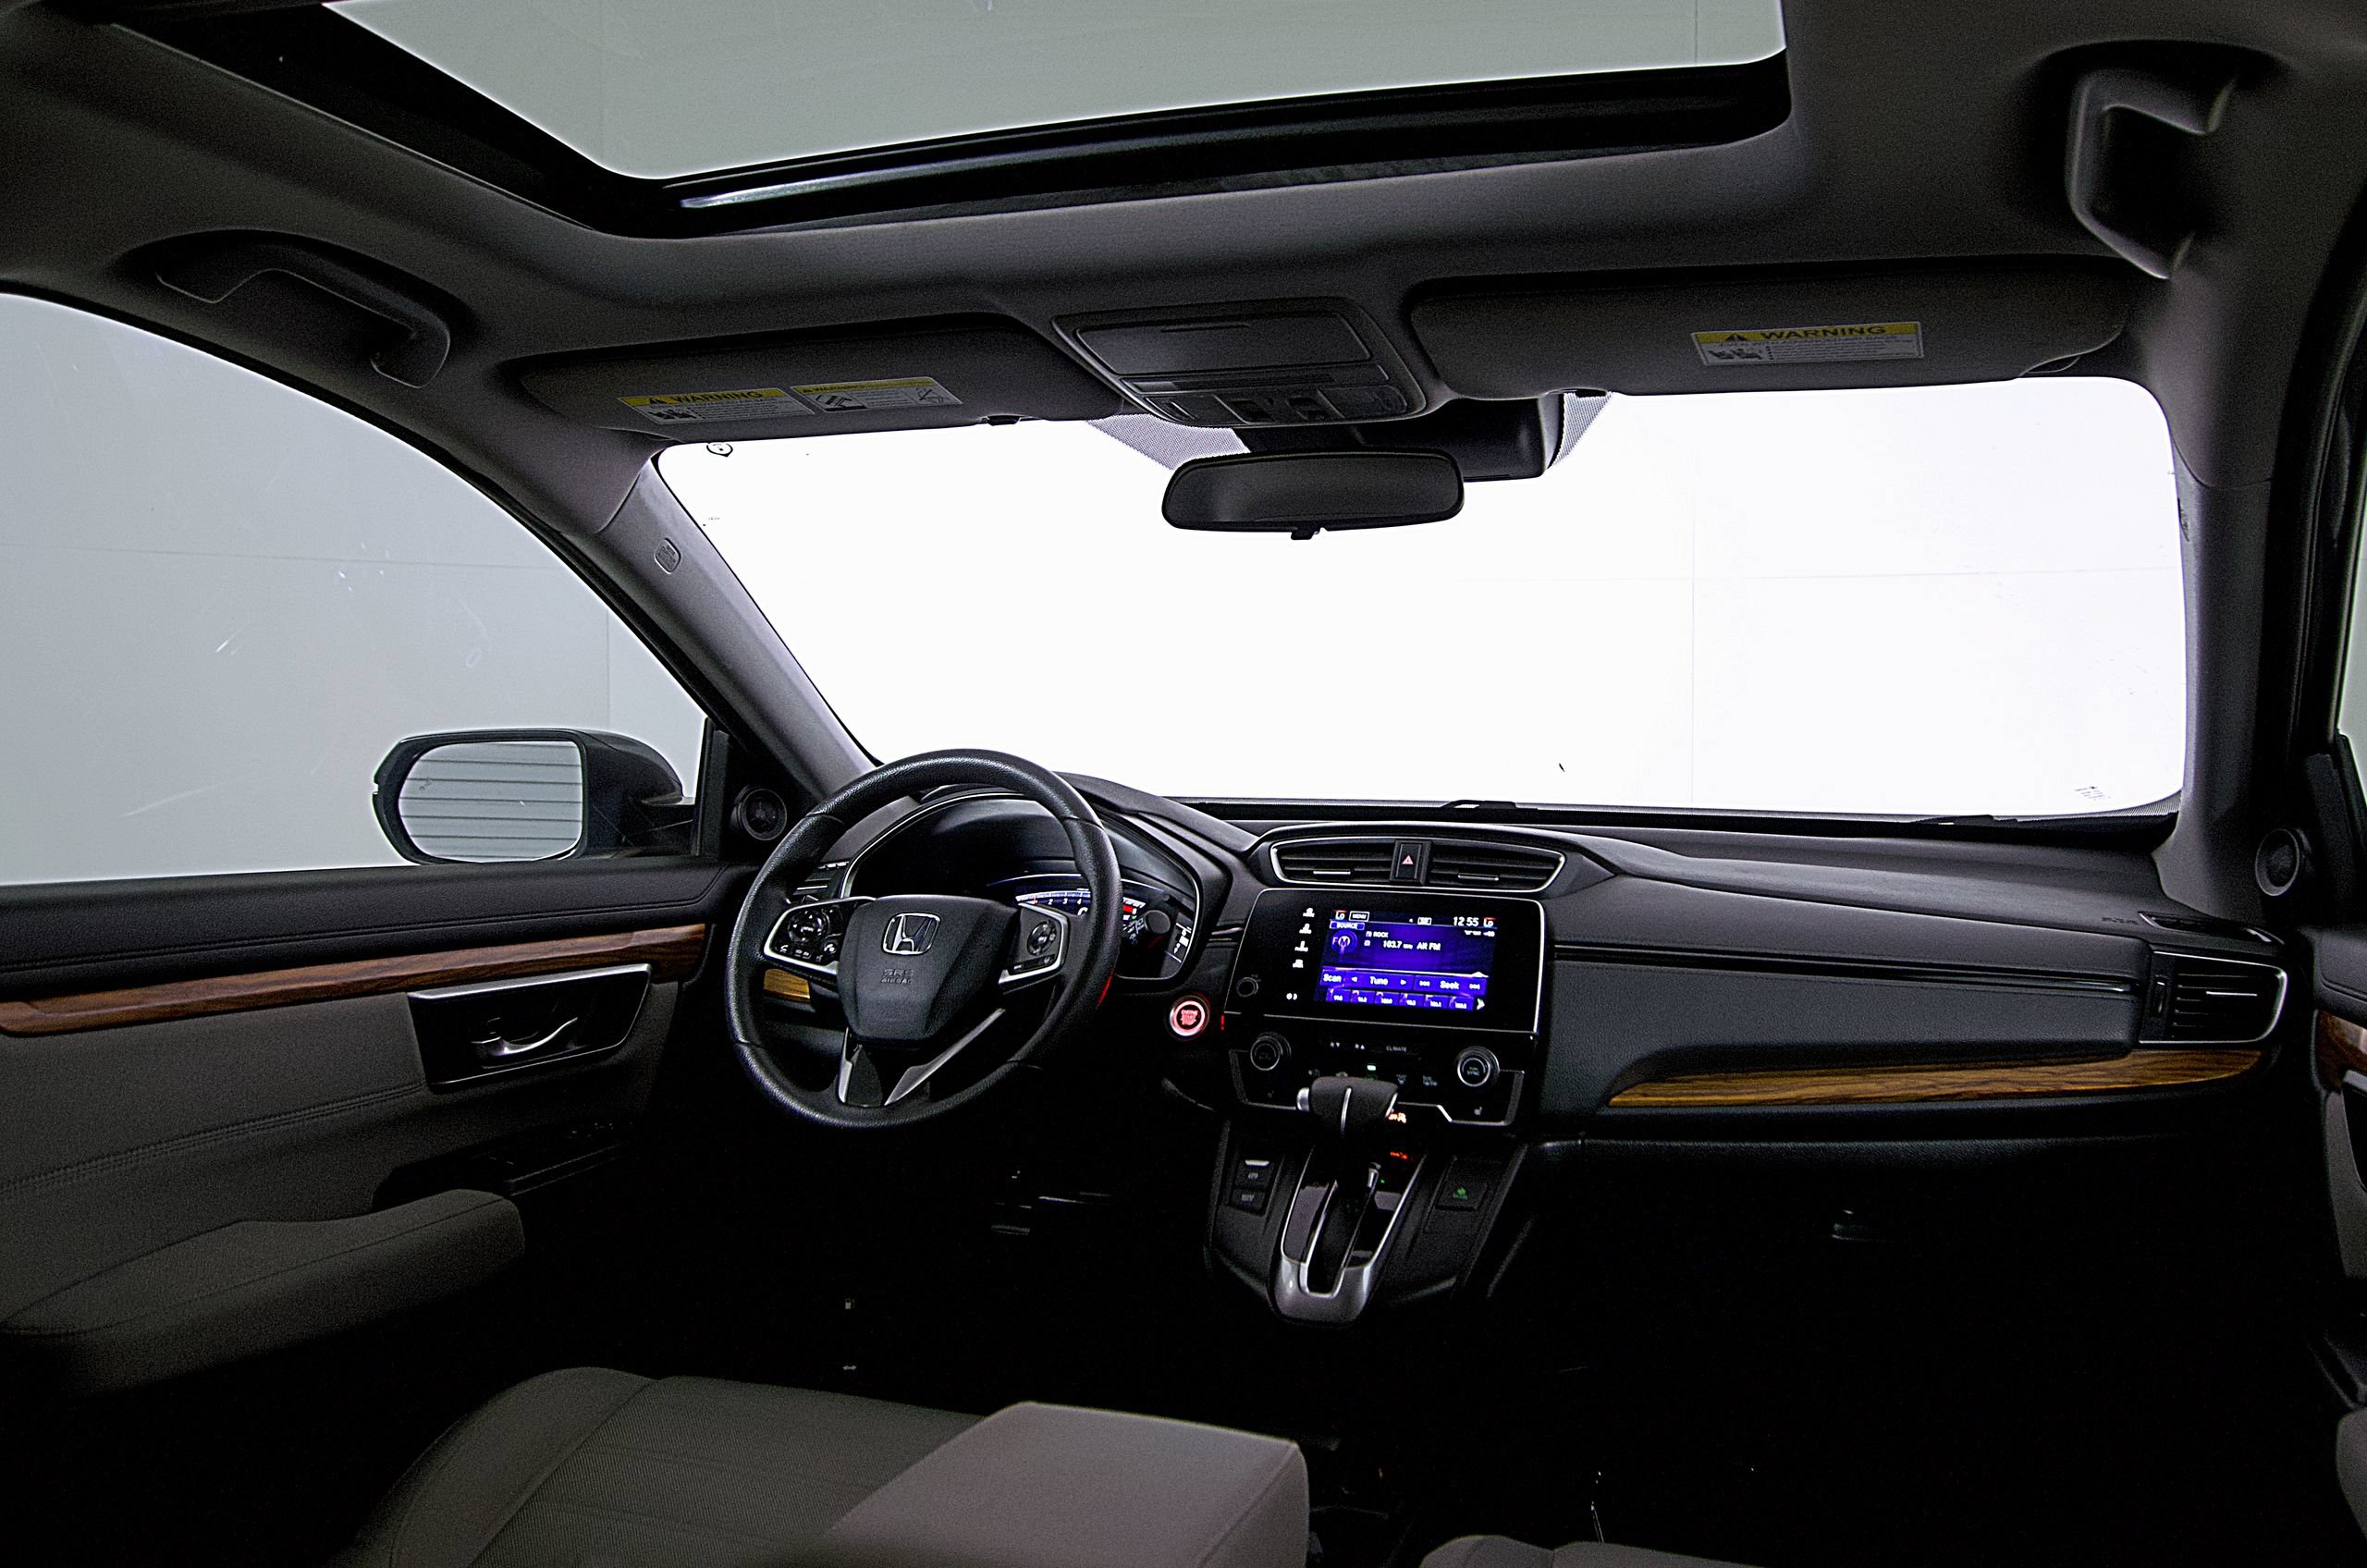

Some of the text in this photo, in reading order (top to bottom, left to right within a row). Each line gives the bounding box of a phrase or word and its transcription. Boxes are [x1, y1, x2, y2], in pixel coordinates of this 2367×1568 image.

[1760, 325, 1887, 340] WARNING
[670, 389, 764, 405] WARNING
[1323, 974, 1342, 983] Scan
[1369, 976, 1389, 986] Tune
[1440, 981, 1460, 990] Seek
